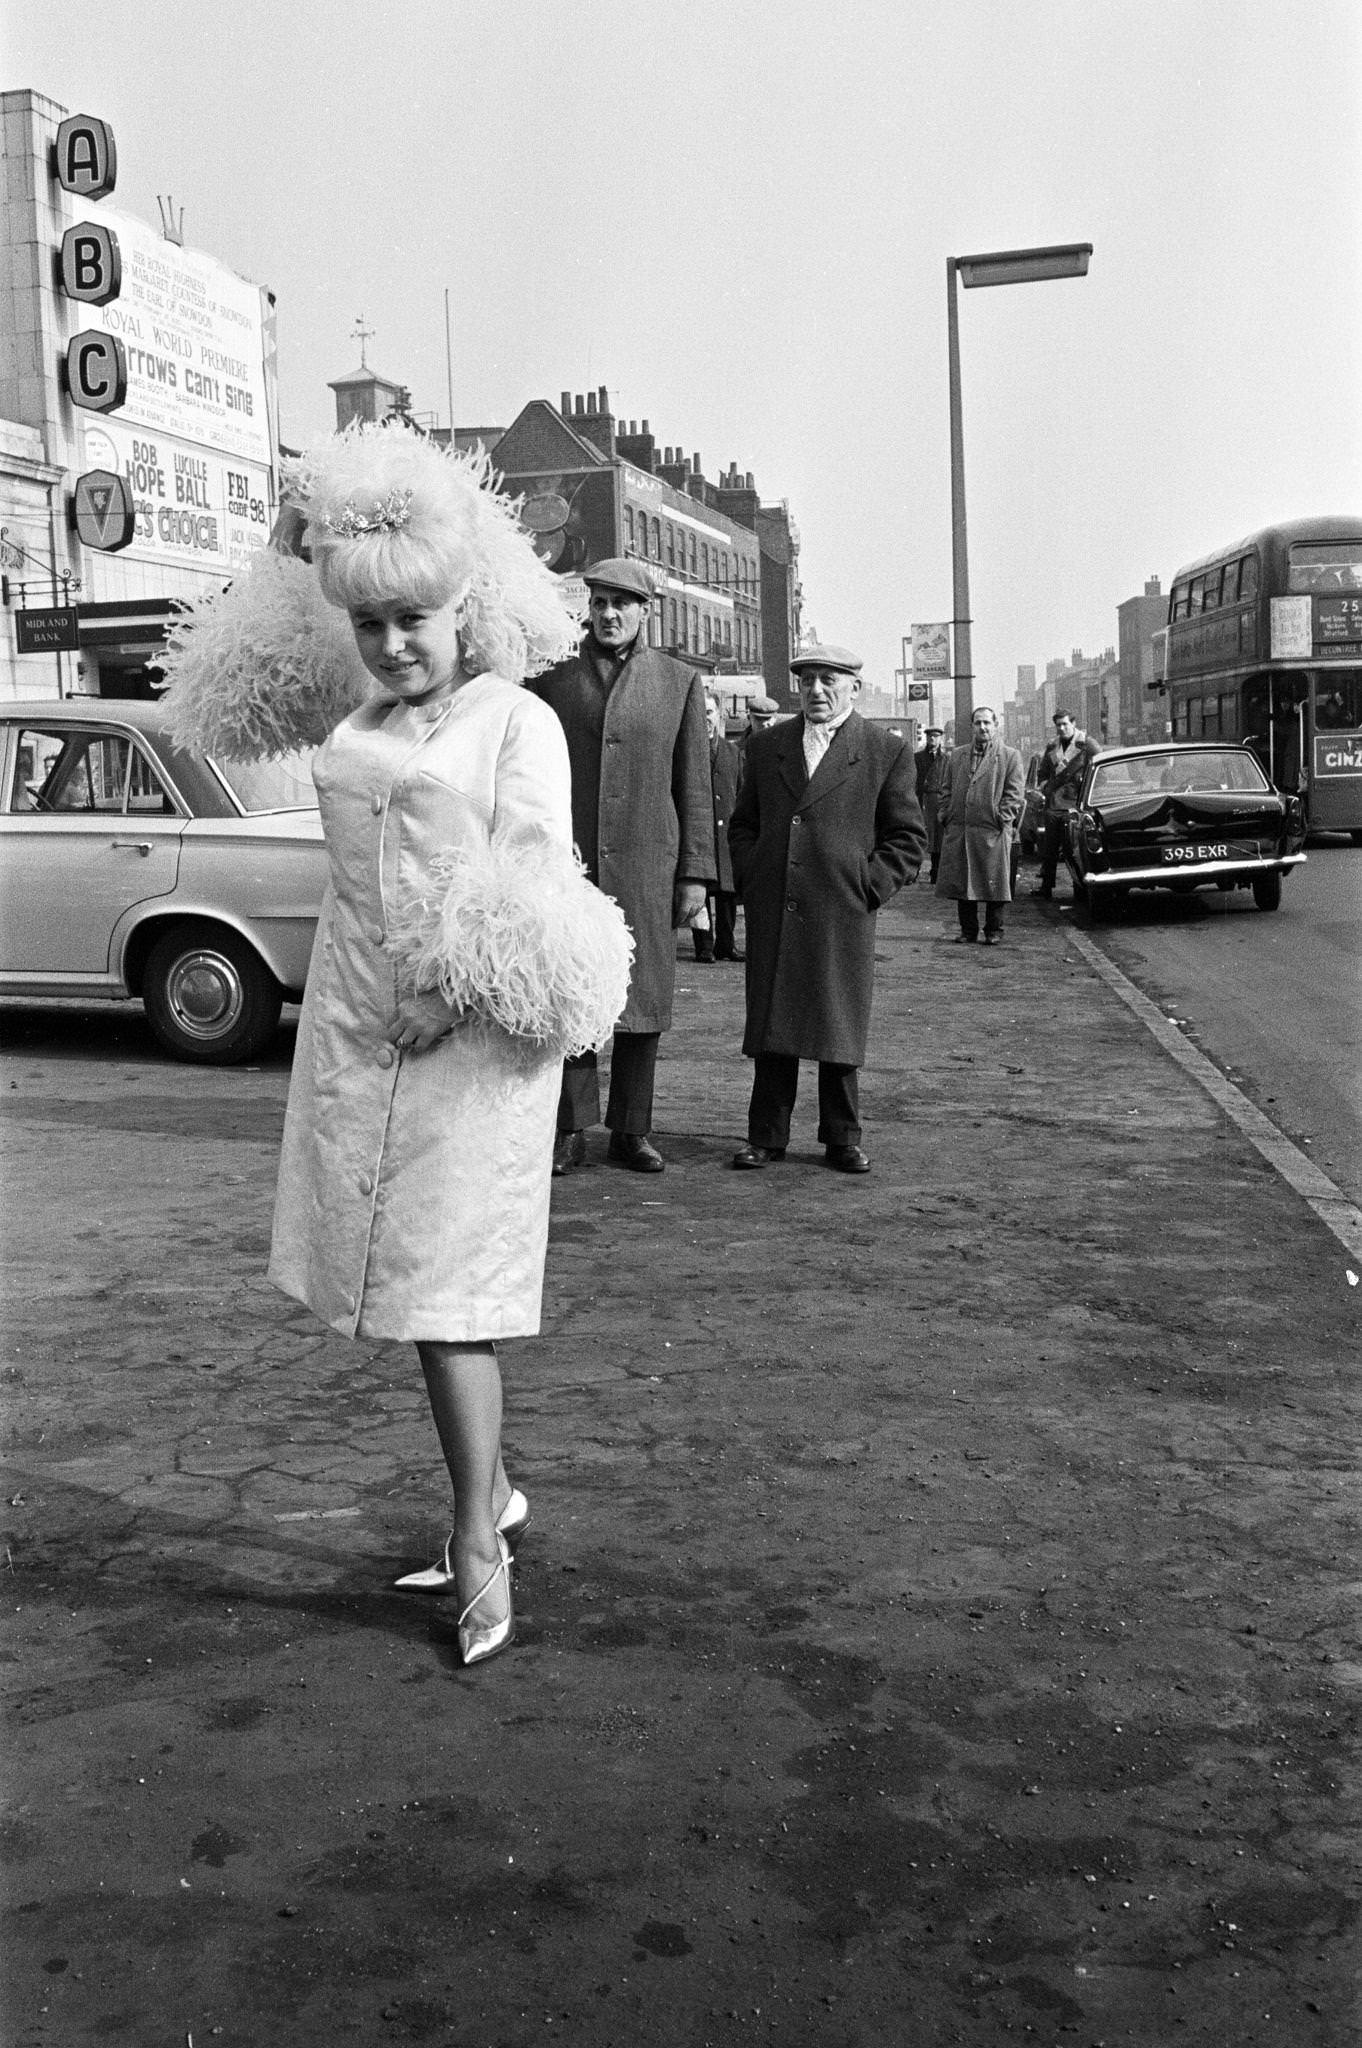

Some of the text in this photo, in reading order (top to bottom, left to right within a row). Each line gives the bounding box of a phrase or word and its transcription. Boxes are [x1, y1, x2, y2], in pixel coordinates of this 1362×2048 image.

[67, 128, 99, 183] A
[74, 236, 104, 290] B
[102, 306, 144, 340] ROYAL
[153, 326, 192, 358] WORLD
[201, 346, 249, 382] PREMIERE
[79, 342, 109, 397] C
[226, 384, 253, 418] sing
[133, 440, 157, 466] BOB
[174, 453, 208, 482] LUCILLE
[126, 459, 165, 498] HOPE
[176, 474, 211, 510] BALL
[227, 471, 249, 501] FBI
[228, 500, 249, 518] CODE
[158, 506, 218, 551] CHOICE
[1341, 600, 1359, 613] 25
[26, 617, 69, 629] MIDLAND
[34, 632, 61, 642] BANK
[1164, 845, 1228, 861] 395 EXR
